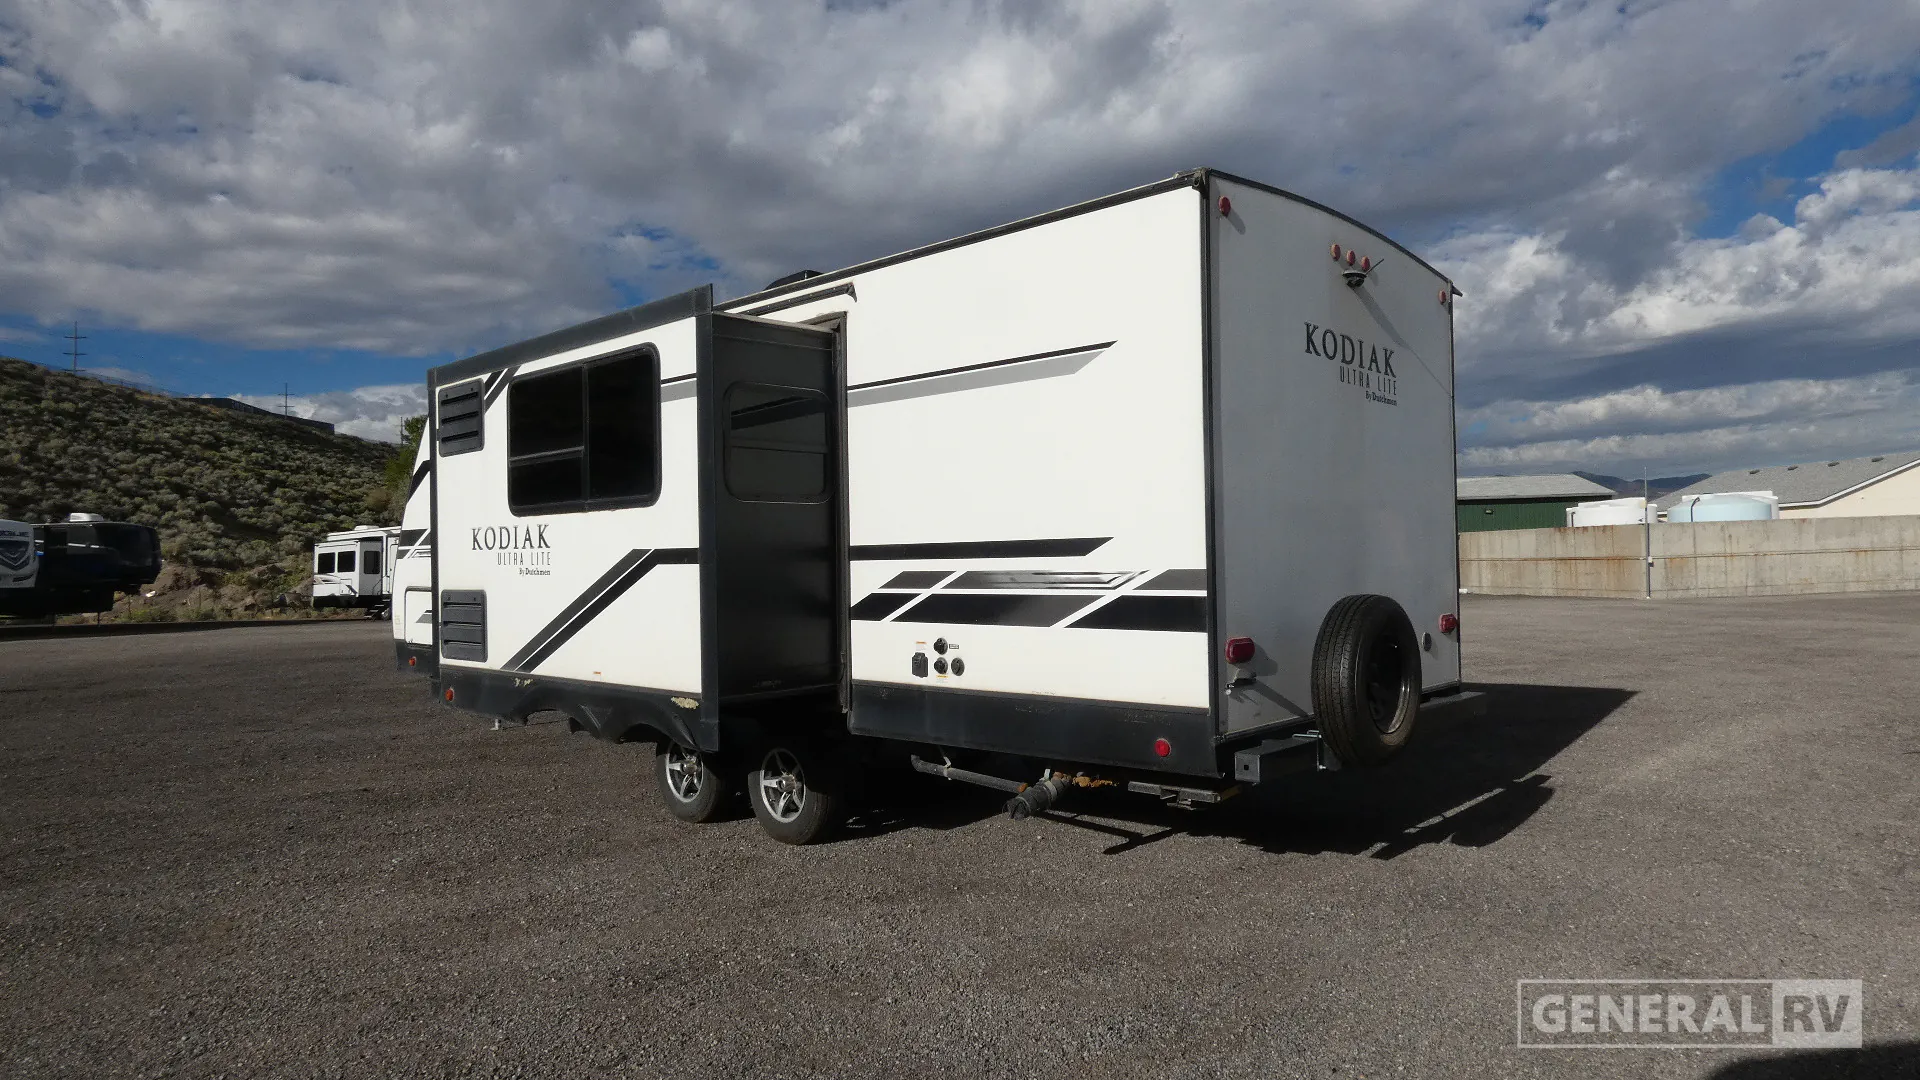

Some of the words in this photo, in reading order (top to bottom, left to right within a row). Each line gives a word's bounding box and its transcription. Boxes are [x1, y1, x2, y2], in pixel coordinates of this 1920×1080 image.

[1304, 321, 1396, 378] KODIAK
[1339, 365, 1370, 388] ULTRA
[1377, 376, 1397, 396] LITE
[1371, 391, 1398, 406] Dutchmen
[471, 523, 551, 550] KODIAK
[497, 552, 524, 565] ULTRA
[531, 551, 551, 565] LITE
